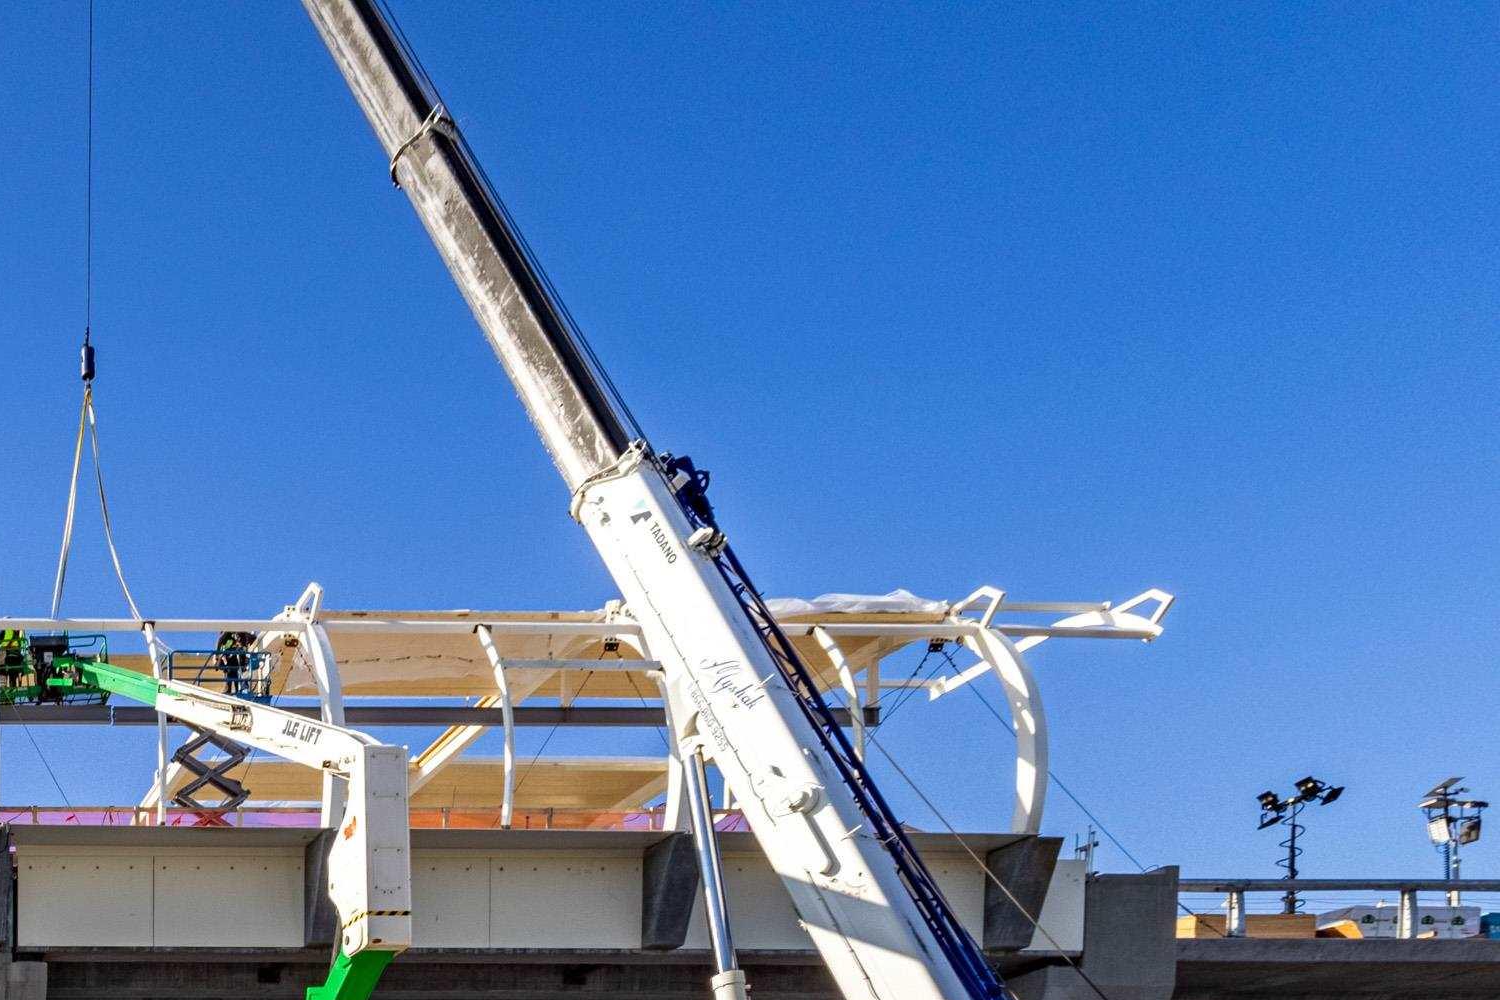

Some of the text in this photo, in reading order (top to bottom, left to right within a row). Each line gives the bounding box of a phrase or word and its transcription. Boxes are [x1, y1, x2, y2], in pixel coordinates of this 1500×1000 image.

[650, 521, 677, 564] TADANO
[282, 719, 323, 745] JLG LIFT
